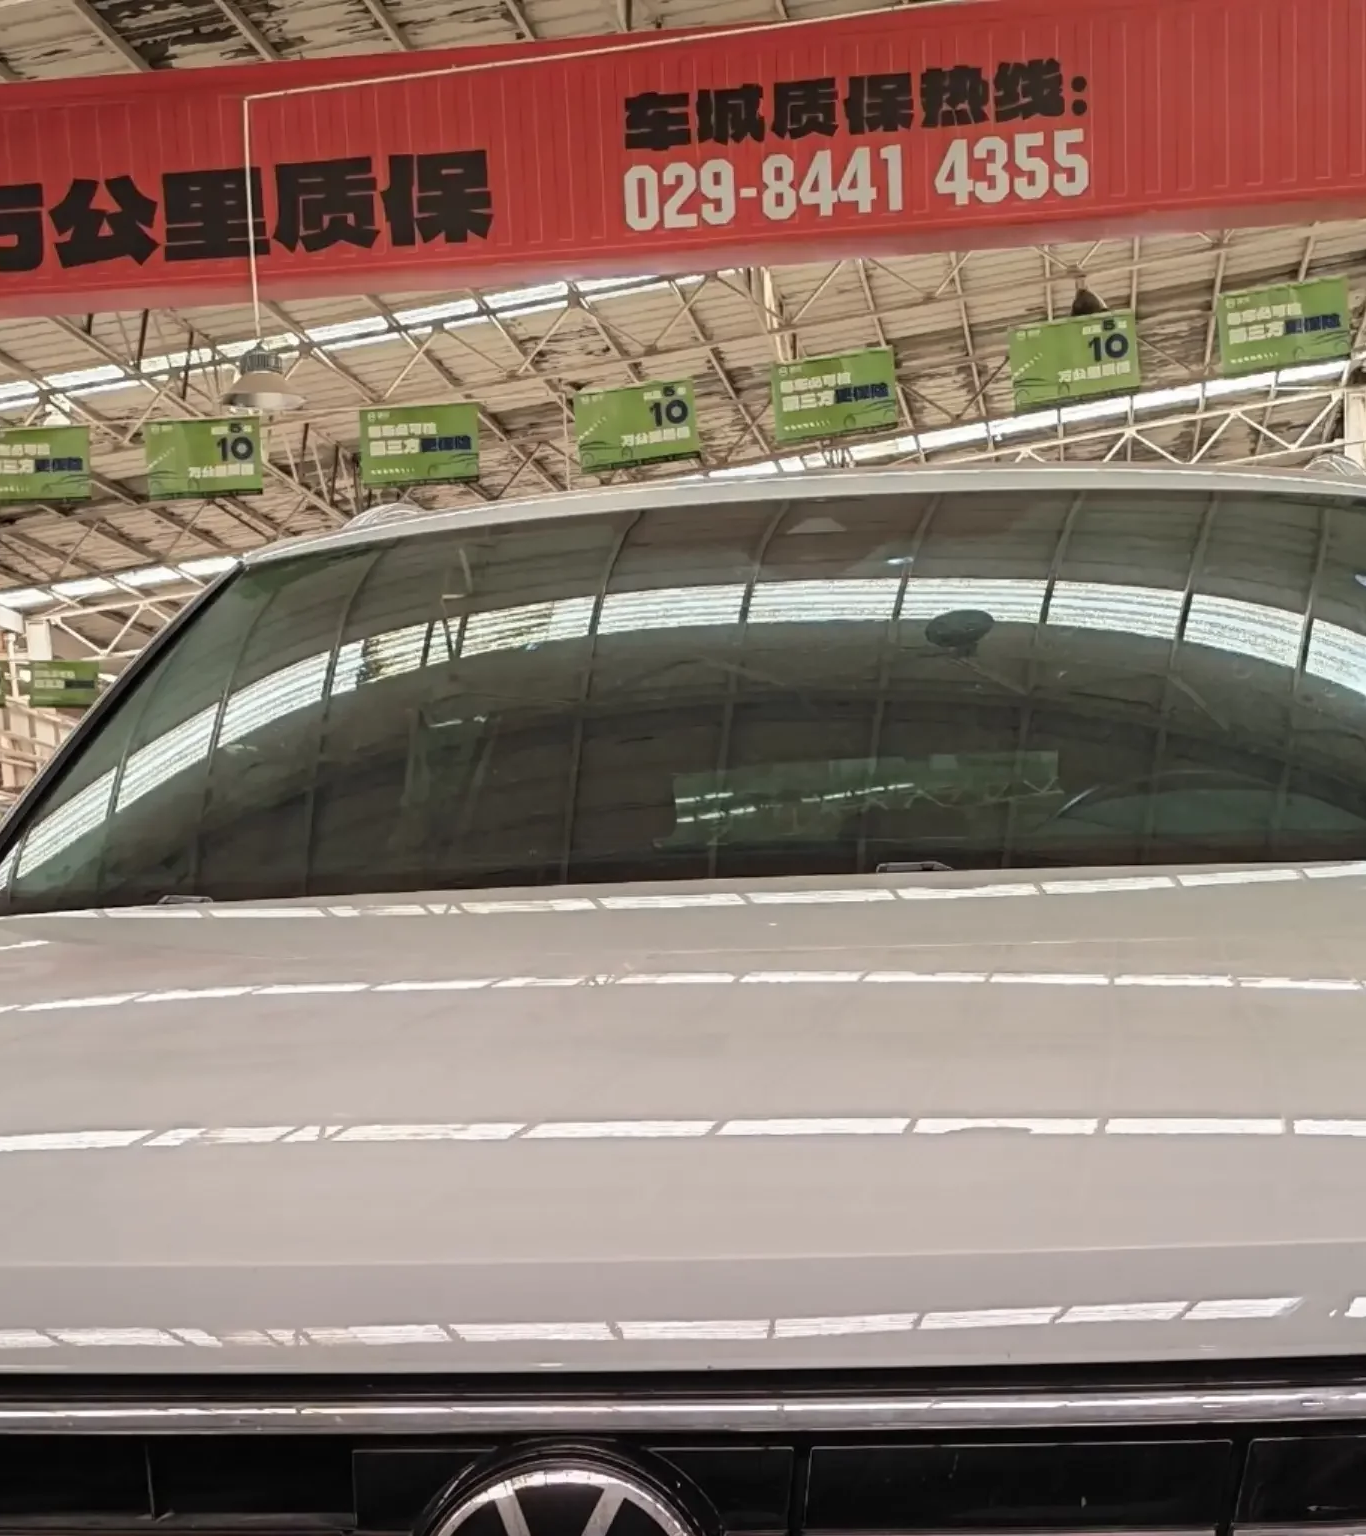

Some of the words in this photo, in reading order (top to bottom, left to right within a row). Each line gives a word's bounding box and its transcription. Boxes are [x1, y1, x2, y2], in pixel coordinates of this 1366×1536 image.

[623, 144, 903, 232] 029-8441
[934, 128, 1090, 206] 4355
[1088, 333, 1129, 362] 10
[649, 399, 688, 427] 10
[216, 436, 254, 462] 10
